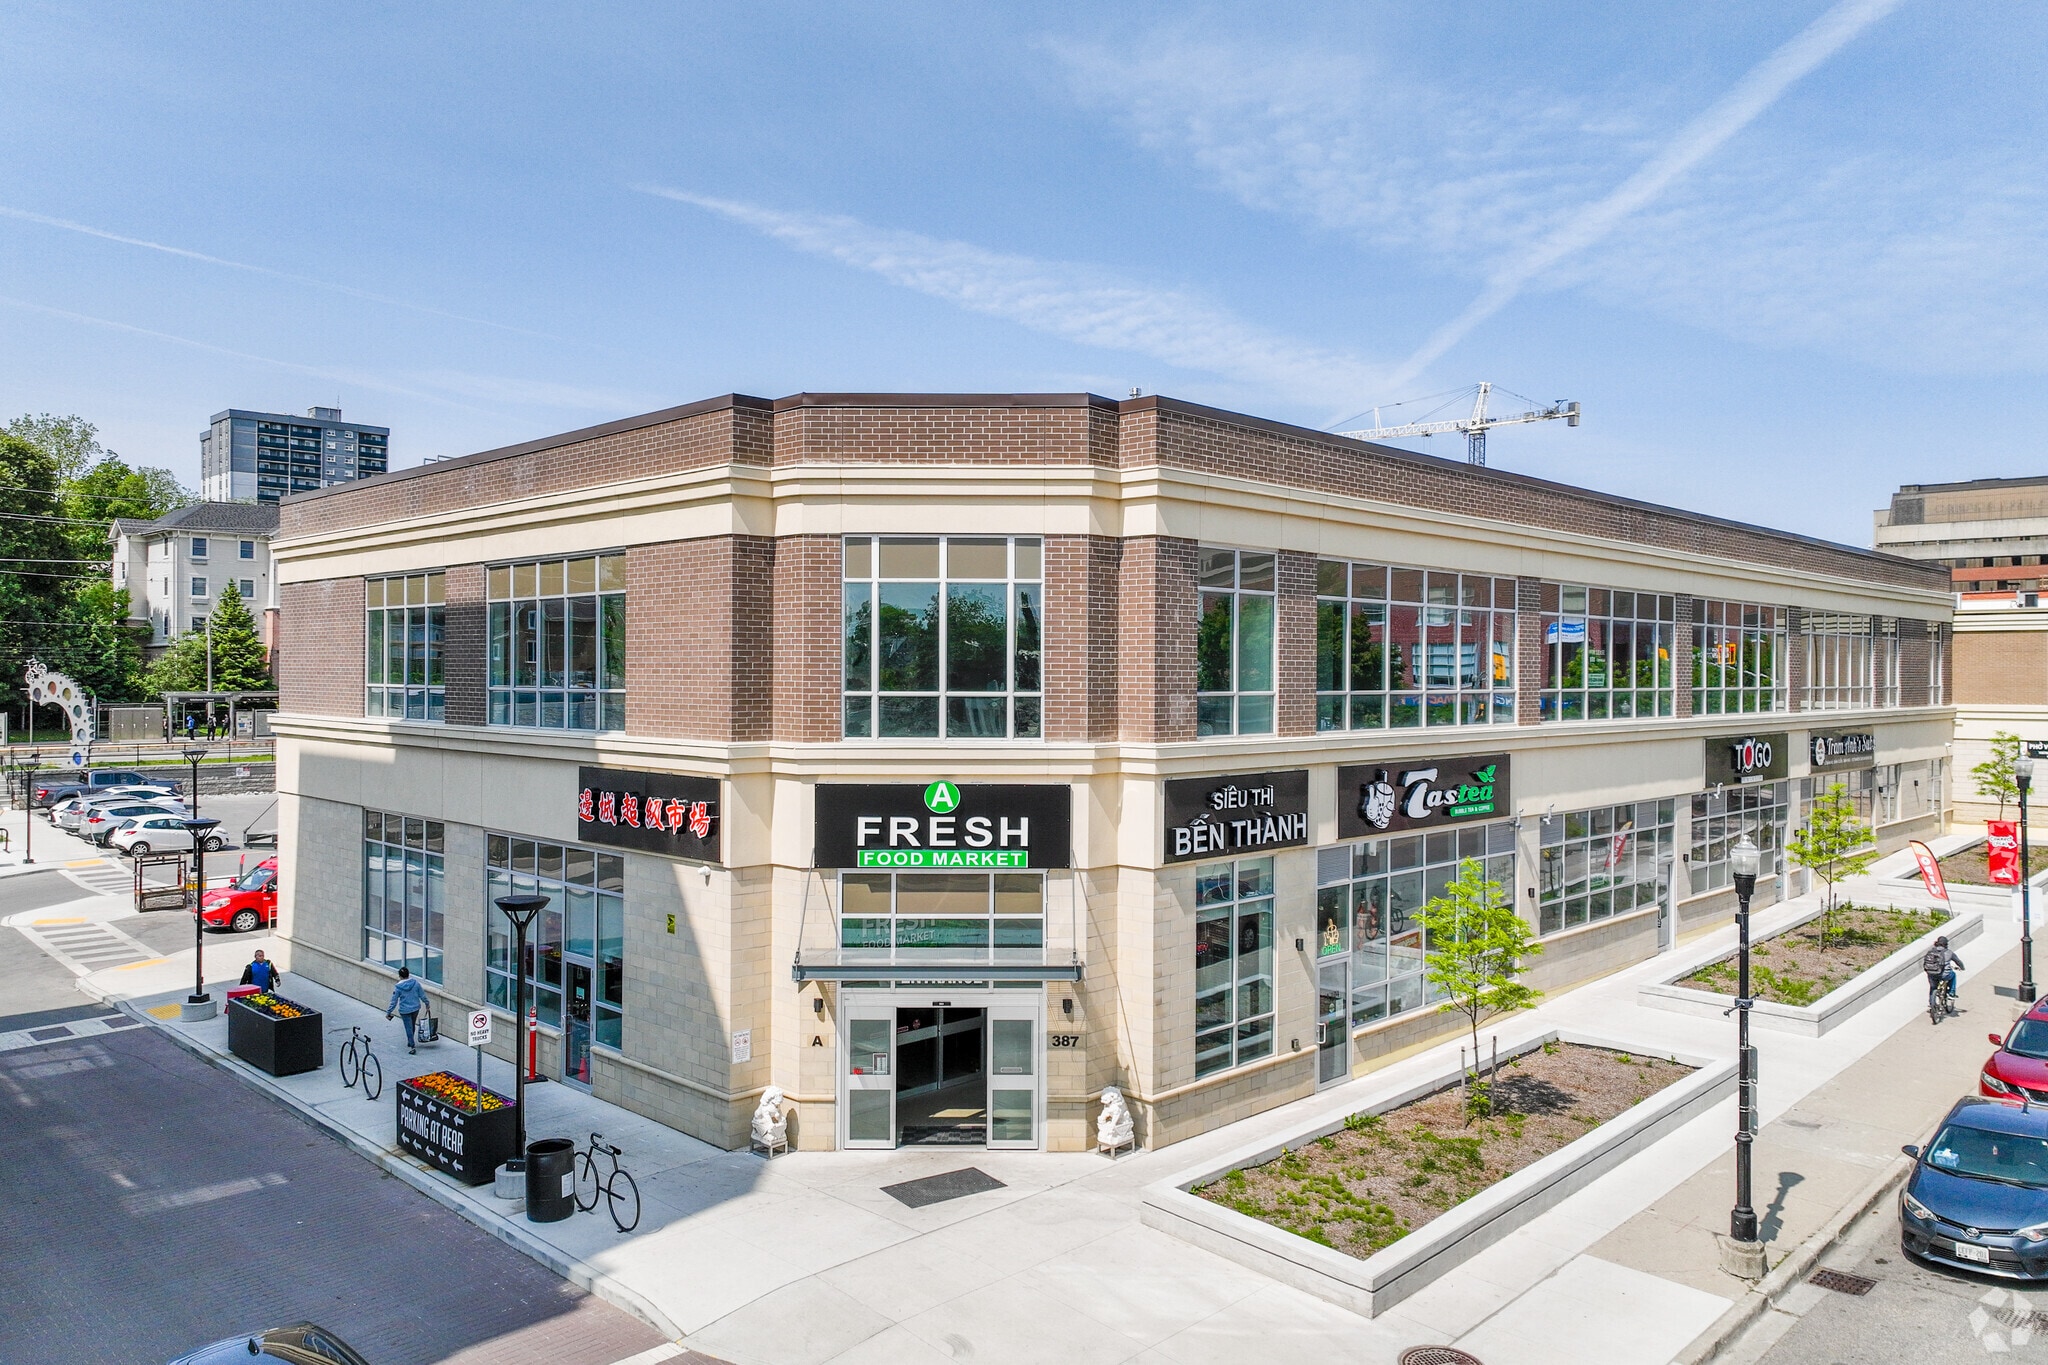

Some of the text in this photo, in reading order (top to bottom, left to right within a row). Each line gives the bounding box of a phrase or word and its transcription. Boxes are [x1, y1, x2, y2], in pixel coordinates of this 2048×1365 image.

[930, 782, 954, 808] A
[1212, 785, 1274, 811] SIÊU THỊ
[1403, 768, 1494, 819] Tastea
[857, 816, 1029, 847] FRESH
[1174, 811, 1307, 856] BẾN THÀNH
[863, 852, 1023, 866] FOOD MARKET
[1321, 943, 1341, 956] OPEN
[811, 1035, 824, 1048] A
[1051, 1035, 1080, 1048] 387
[400, 1103, 464, 1156] PARKING AT REAR
